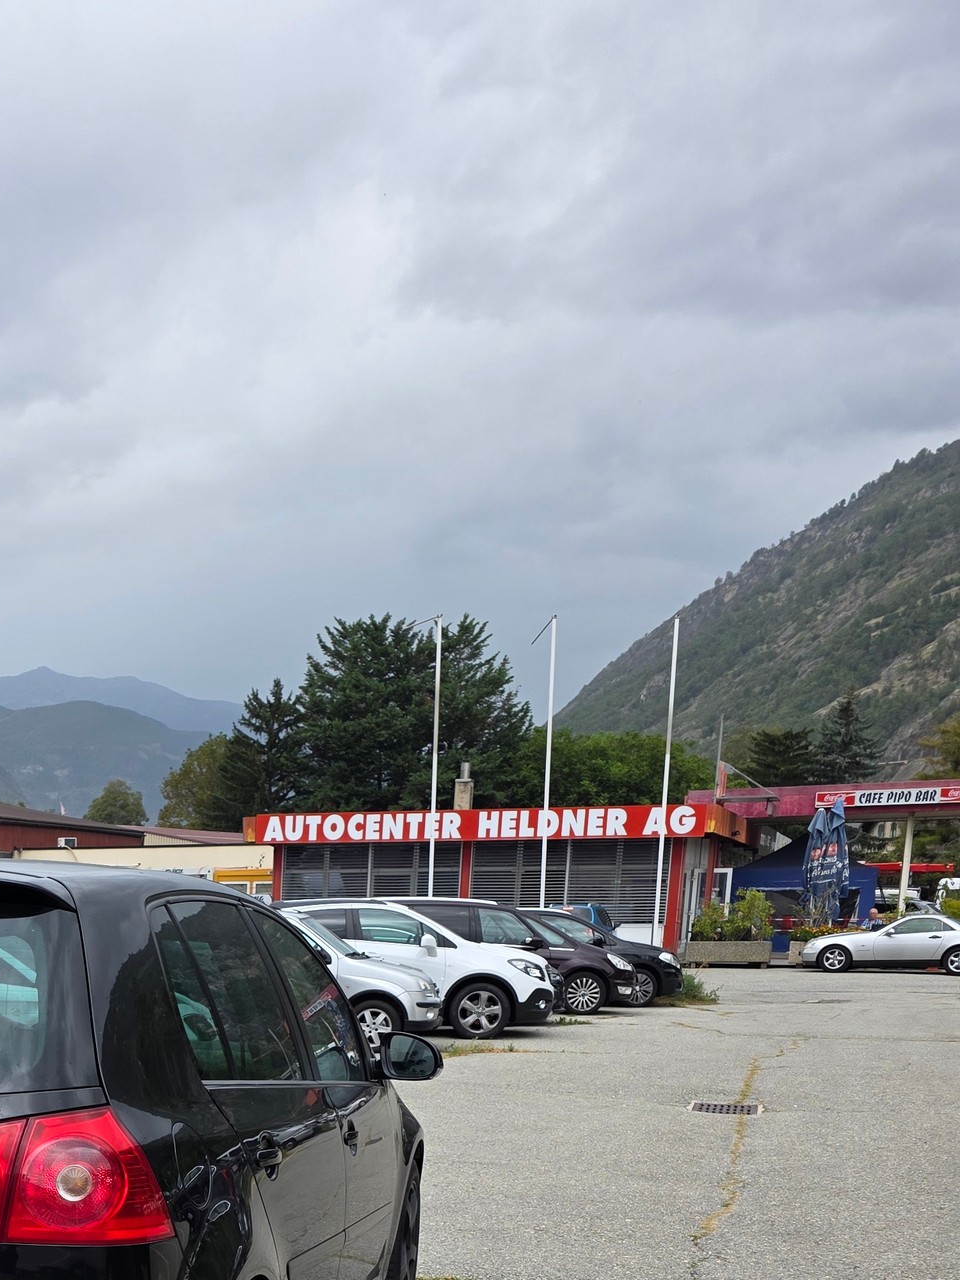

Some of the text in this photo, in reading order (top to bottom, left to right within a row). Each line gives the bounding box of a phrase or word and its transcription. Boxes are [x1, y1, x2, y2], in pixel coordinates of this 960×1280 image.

[858, 789, 937, 805] CAFE PIPO BAR
[263, 805, 697, 842] AUTOCENTER HELDNER AG
